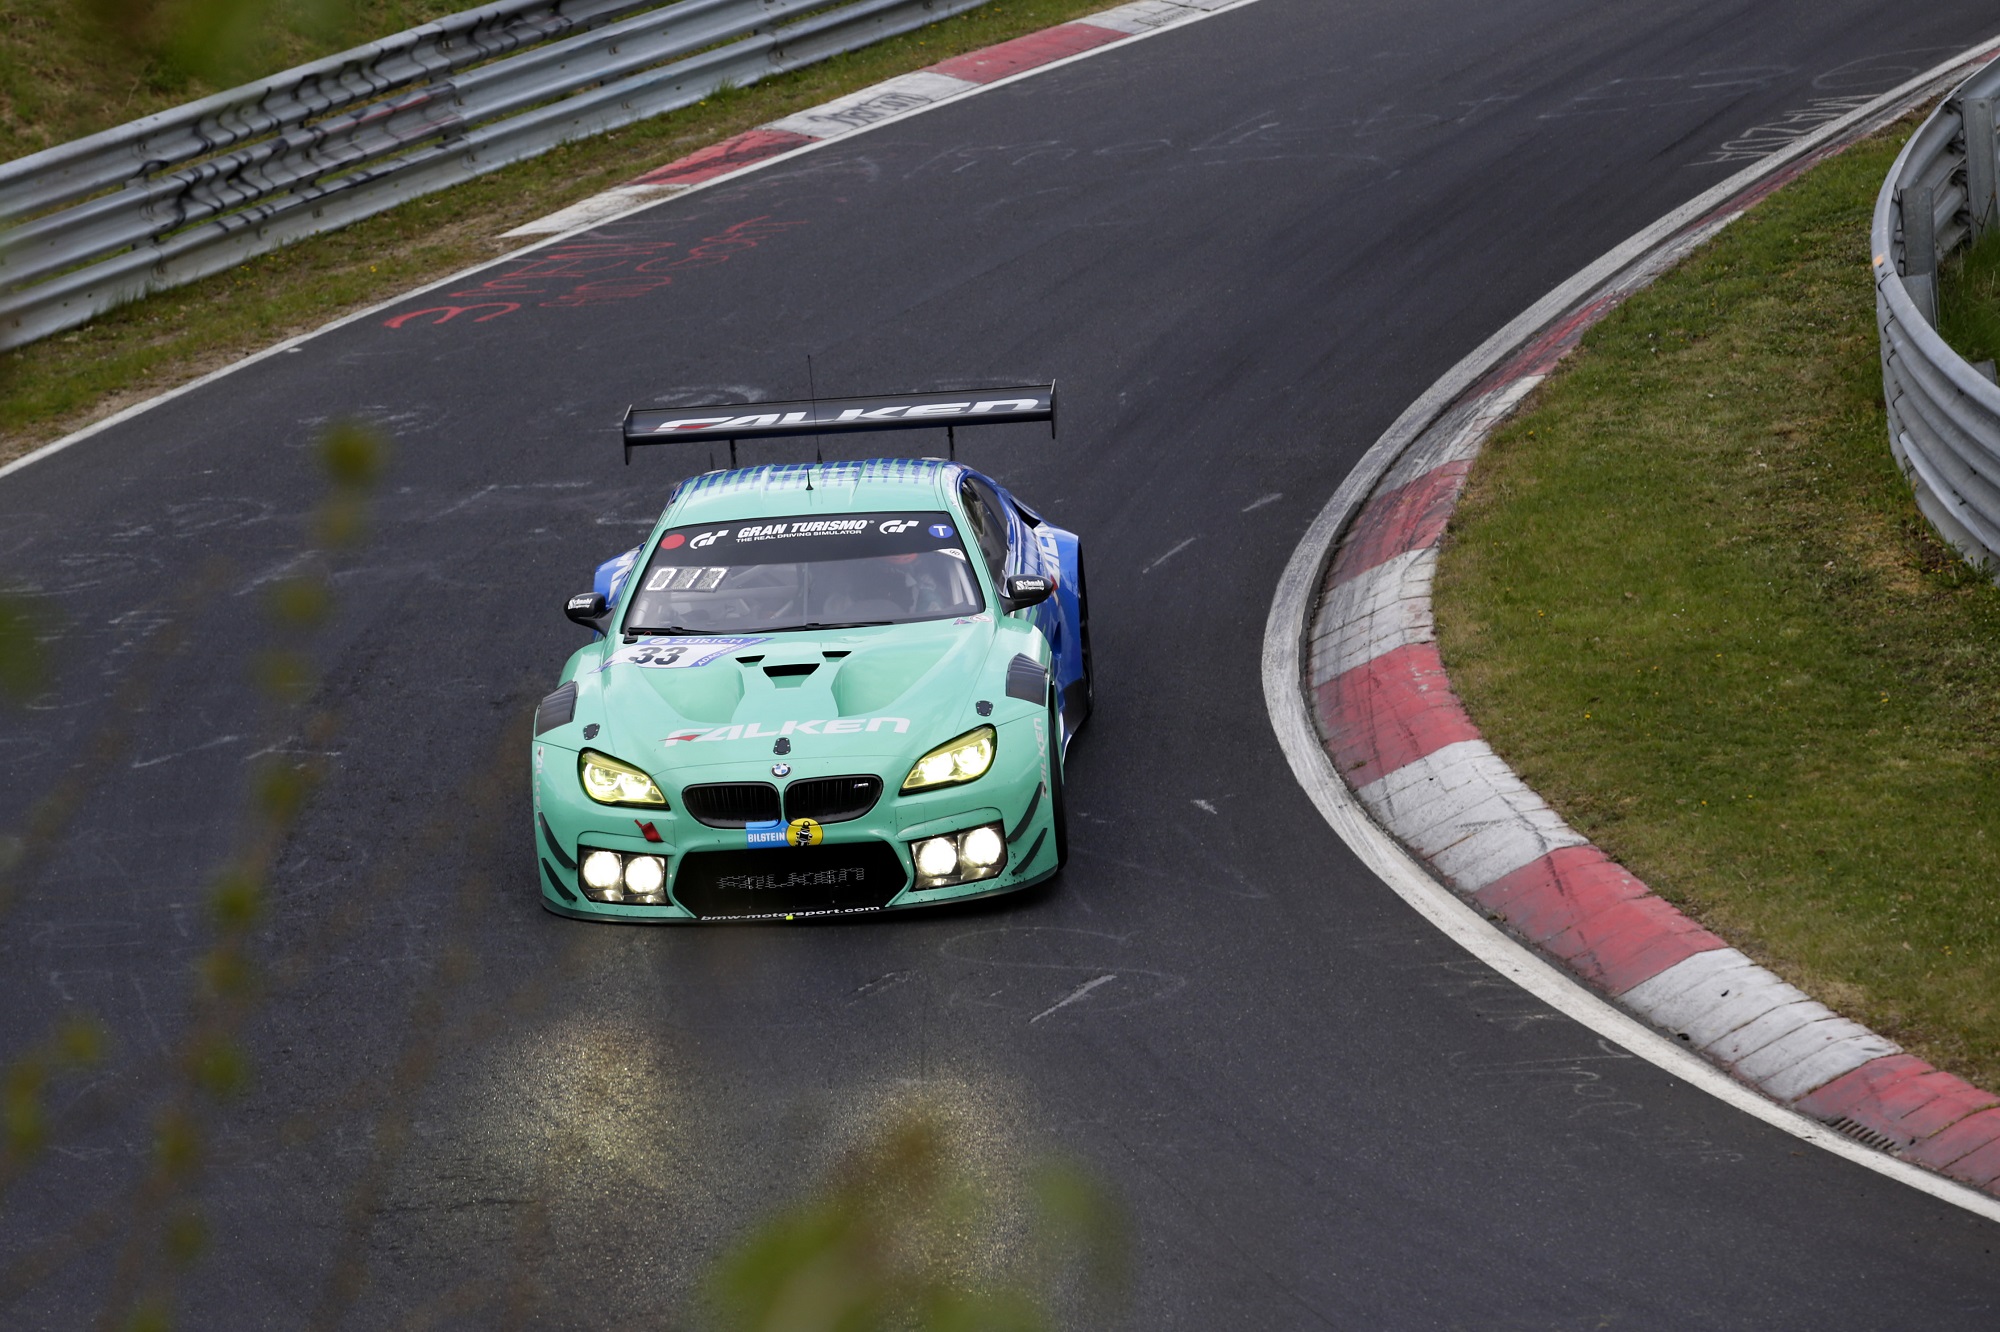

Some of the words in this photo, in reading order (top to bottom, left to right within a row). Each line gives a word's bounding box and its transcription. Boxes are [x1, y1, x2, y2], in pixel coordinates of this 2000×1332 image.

[650, 398, 1039, 433] FALKEN
[737, 523, 787, 539] GRAN
[791, 519, 868, 533] TURISMO
[748, 534, 776, 542] REAL
[777, 532, 808, 540] DRIVING
[808, 529, 862, 538] SIMULATOR
[937, 525, 948, 536] T
[628, 646, 688, 665] 33
[658, 717, 911, 748] FALKEN
[747, 832, 786, 843] BILSTEIN
[700, 906, 880, 921] bmw-motorsport.com
